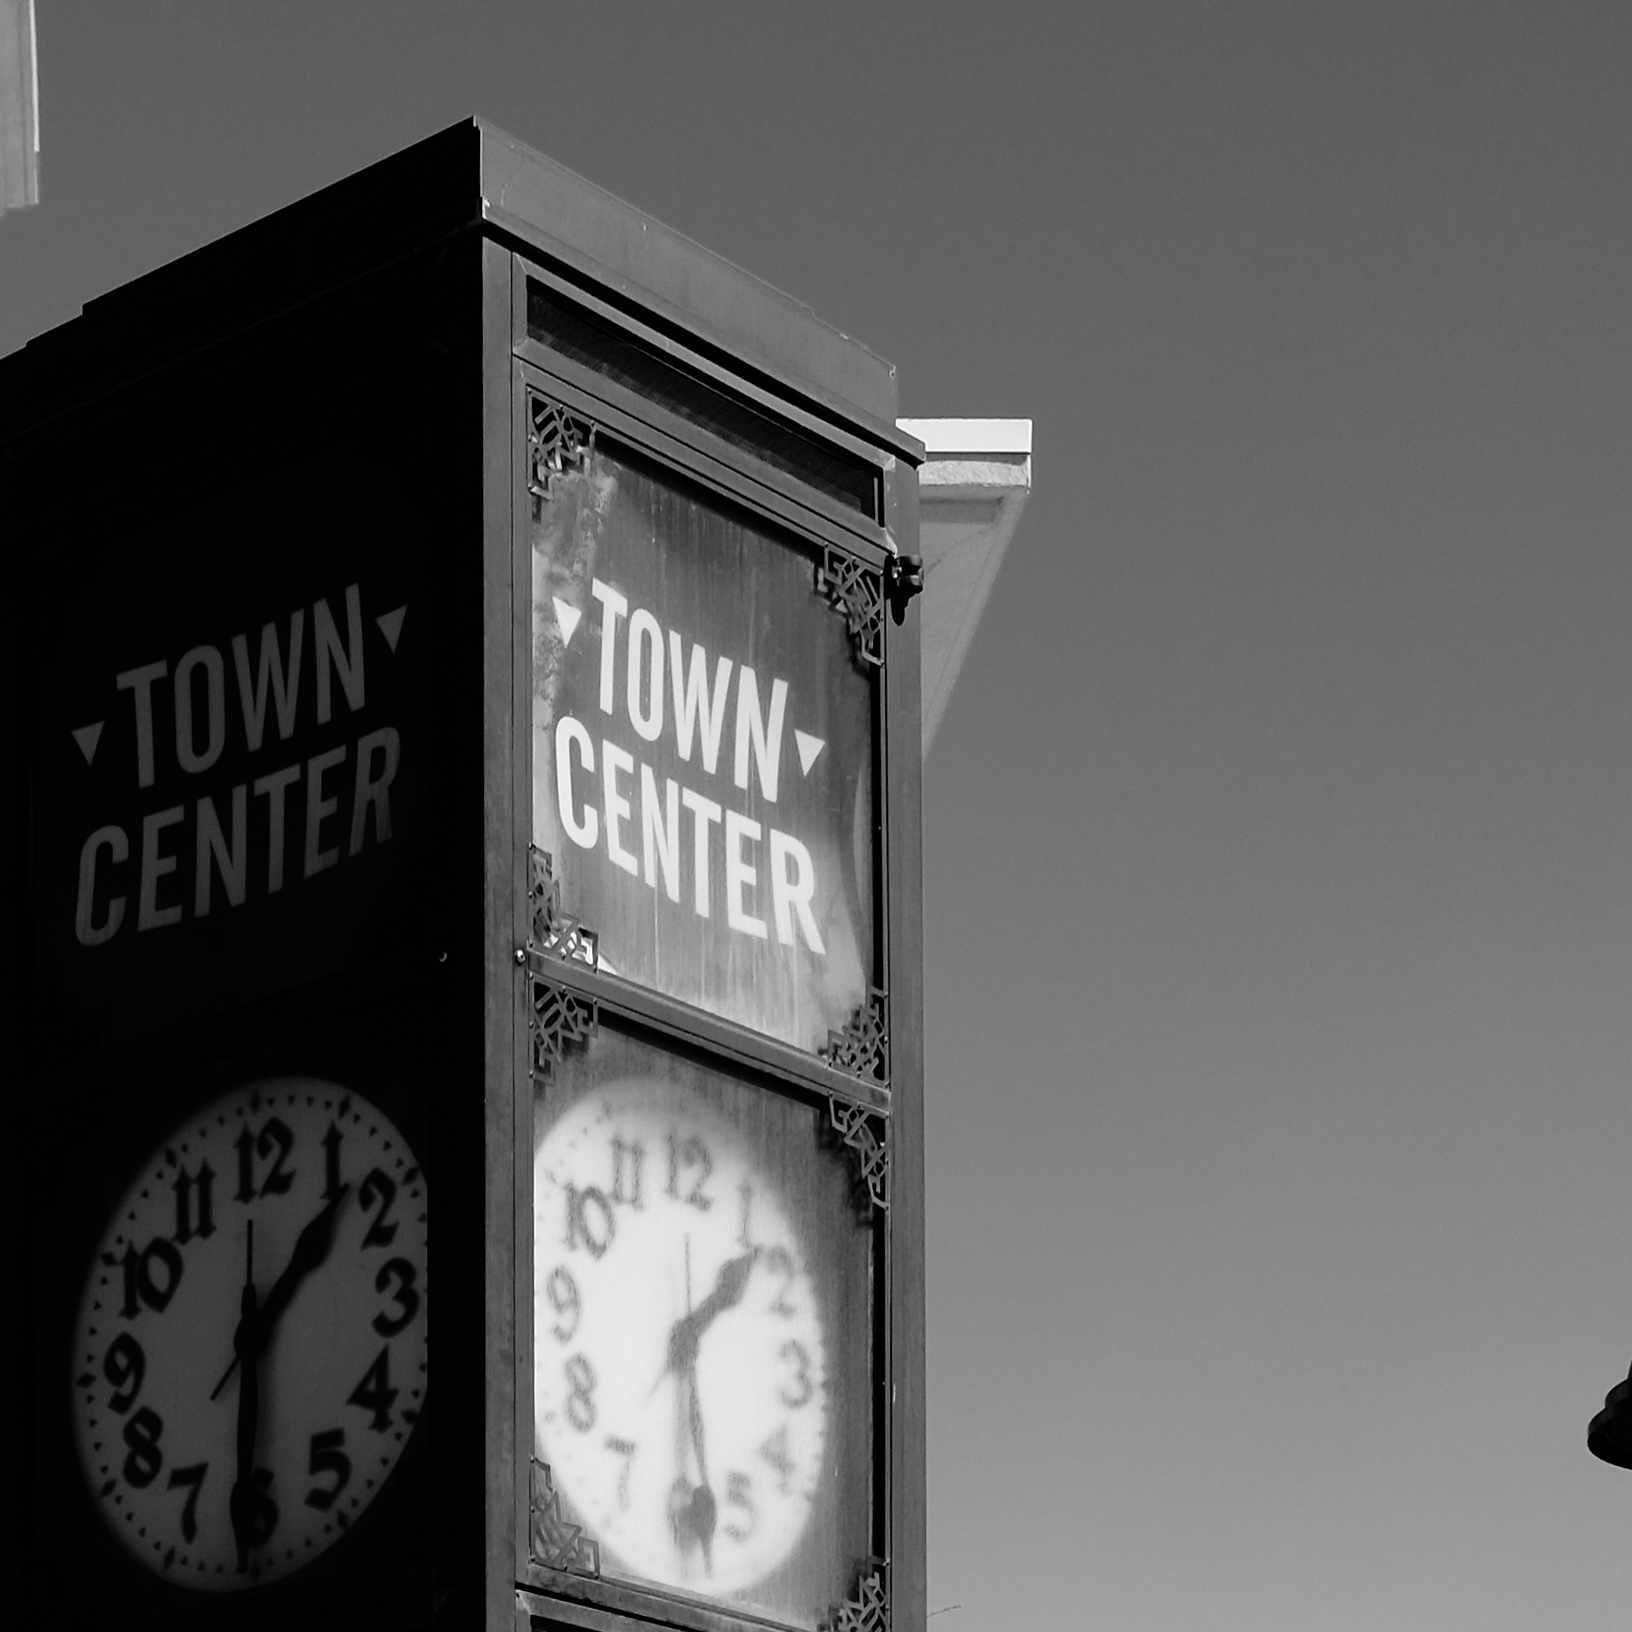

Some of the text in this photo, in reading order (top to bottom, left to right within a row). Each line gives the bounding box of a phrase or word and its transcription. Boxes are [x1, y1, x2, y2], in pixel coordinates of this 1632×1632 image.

[116, 583, 365, 789] TOWN
[591, 577, 788, 803] TOWN
[75, 727, 401, 946] CENTER
[554, 716, 826, 955] CENTER
[233, 1116, 296, 1203] 12
[320, 1119, 345, 1202] 1
[610, 1132, 647, 1211] 11
[665, 1128, 713, 1212] 12
[172, 1158, 216, 1245] 11
[358, 1167, 398, 1251] 2
[563, 1181, 615, 1261] 10
[737, 1178, 753, 1249] 1
[118, 1236, 183, 1321] 10
[372, 1257, 420, 1338] 3
[546, 1264, 581, 1344] 9
[766, 1245, 796, 1320] 2
[103, 1332, 145, 1415] 9
[345, 1344, 399, 1433] 4
[564, 1351, 597, 1433] 8
[780, 1339, 813, 1410] 3
[123, 1406, 163, 1489] 8
[304, 1427, 351, 1512] 5
[604, 1434, 636, 1513] 7
[760, 1424, 792, 1495] 4
[167, 1462, 208, 1546] 7
[724, 1470, 759, 1542] 5
